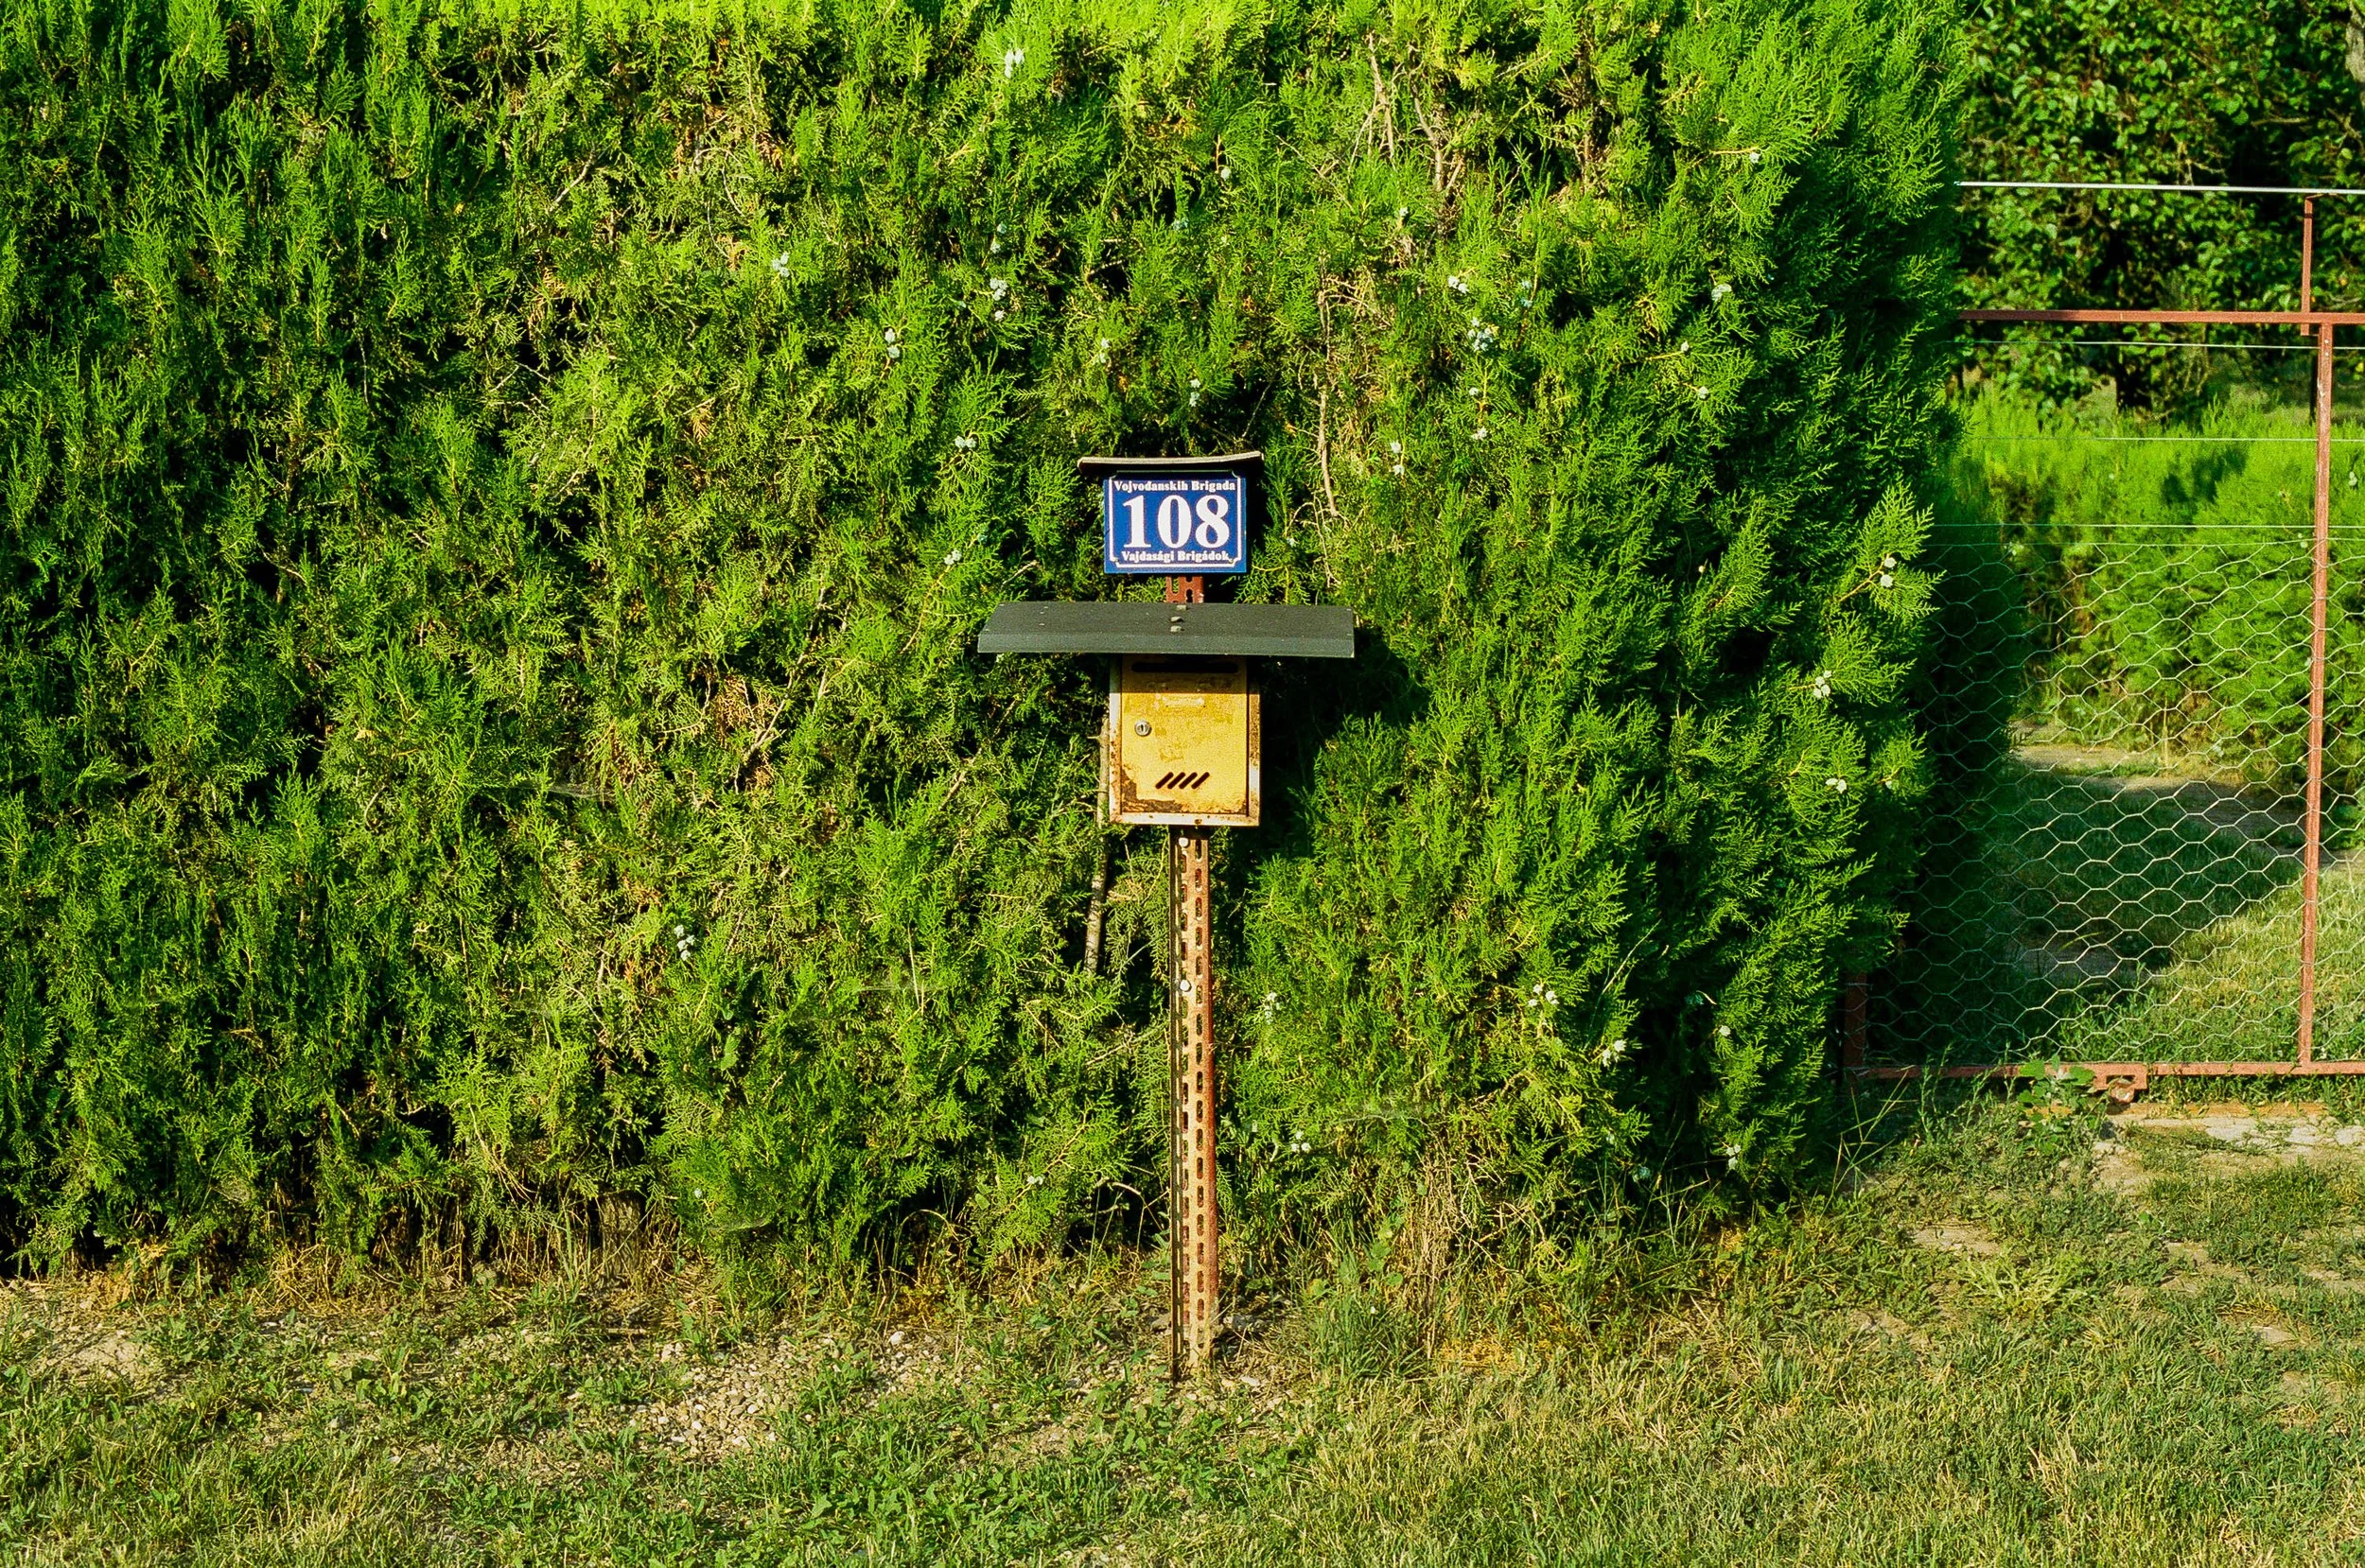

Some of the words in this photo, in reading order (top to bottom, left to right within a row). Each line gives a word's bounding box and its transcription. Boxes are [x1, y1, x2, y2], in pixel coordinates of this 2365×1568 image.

[1191, 480, 1235, 493] Brigada
[1122, 495, 1230, 549] 108
[1121, 550, 1175, 563] Vajdasági
[1178, 550, 1230, 563] Brigádok
